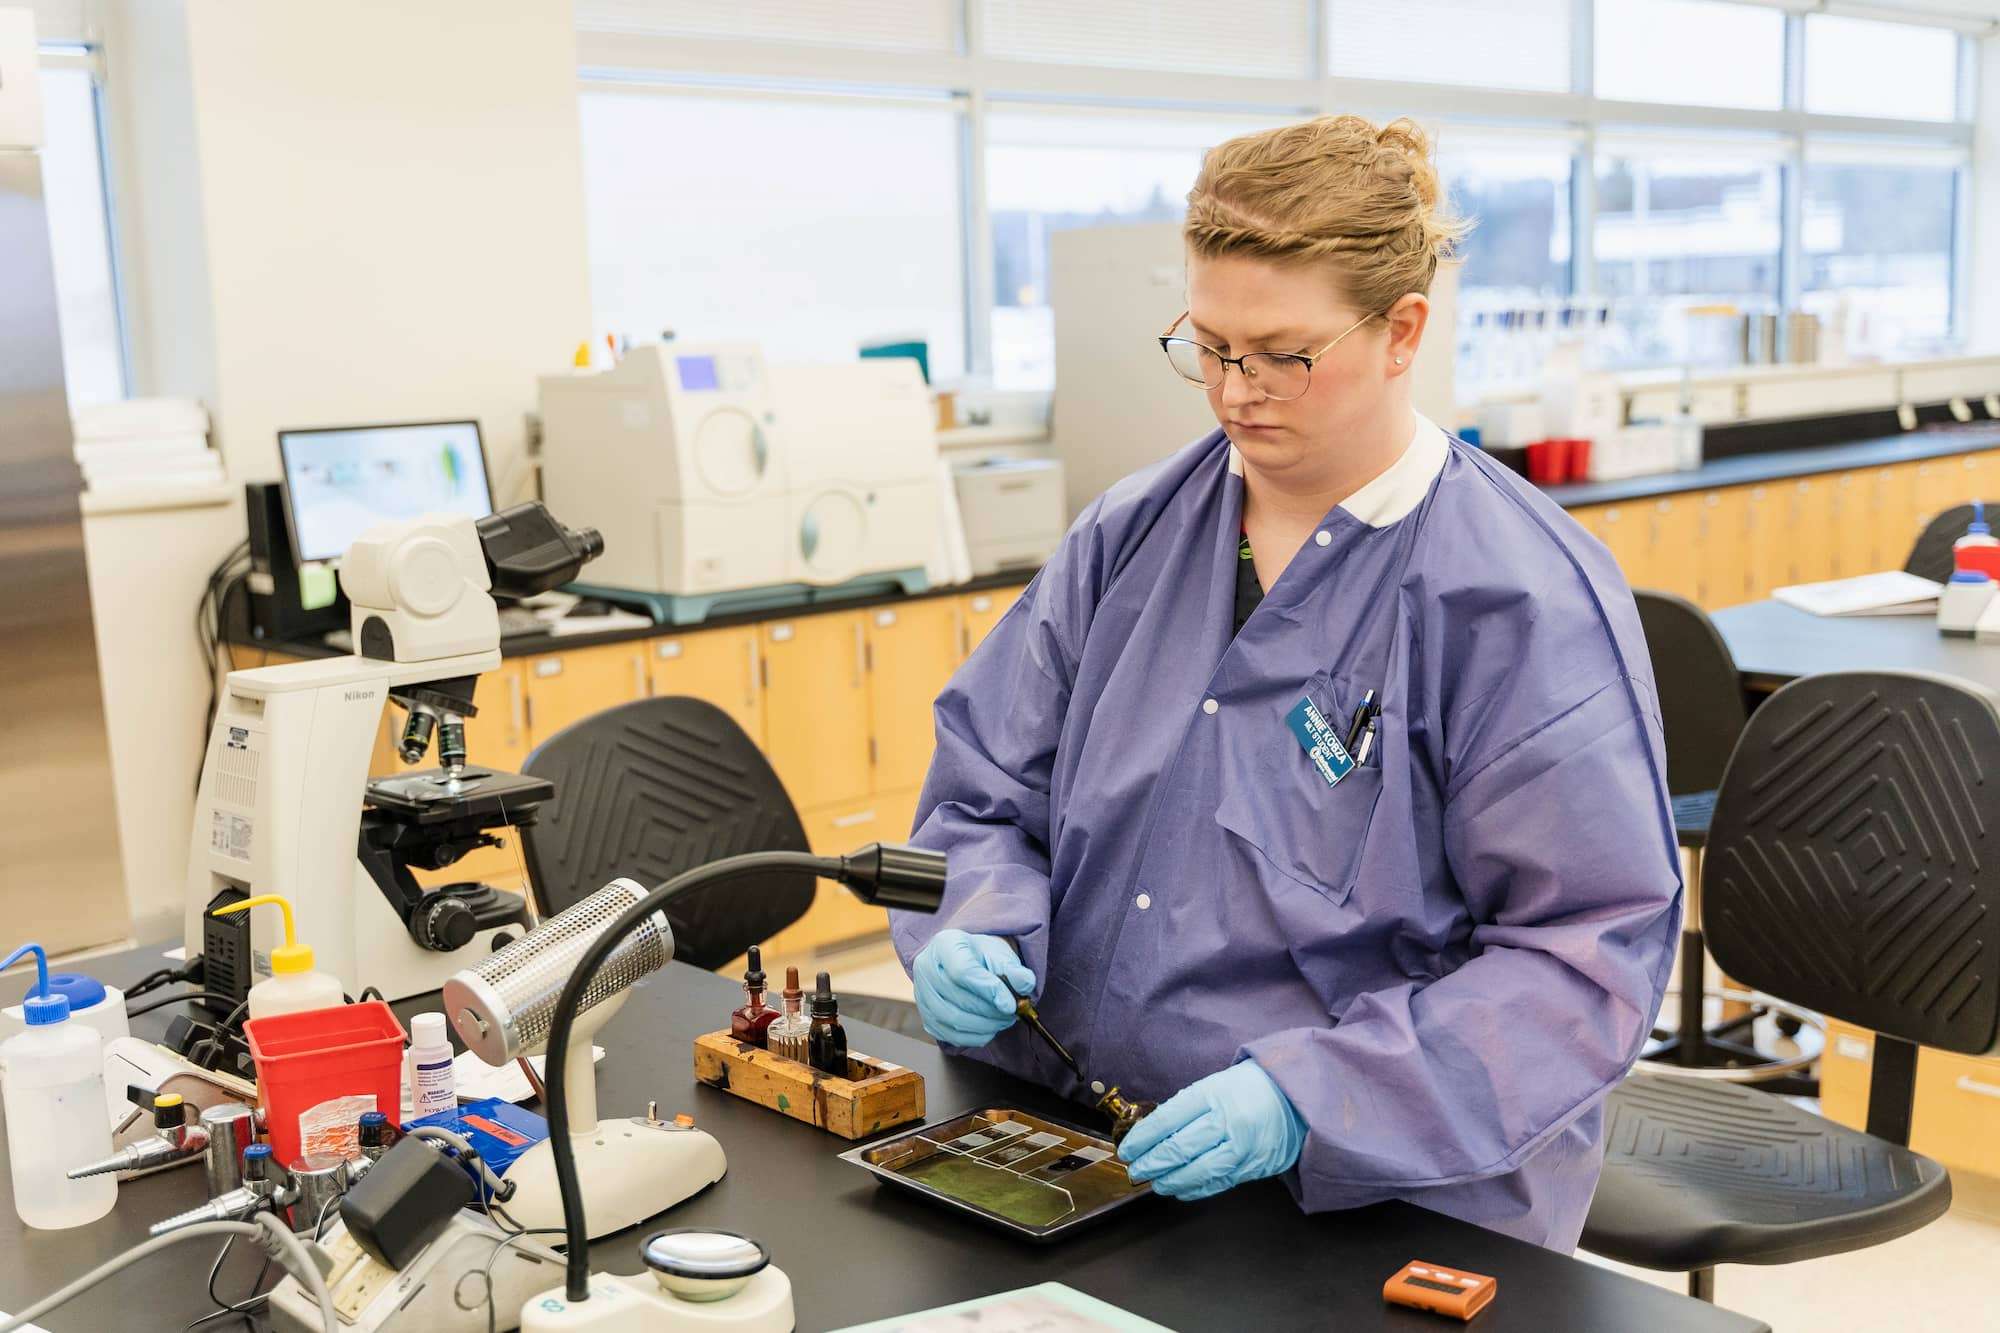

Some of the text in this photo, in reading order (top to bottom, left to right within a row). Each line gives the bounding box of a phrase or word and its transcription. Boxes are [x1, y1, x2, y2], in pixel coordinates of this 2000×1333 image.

[344, 690, 375, 702] Nikon
[1303, 705, 1327, 734] ANNIE
[1322, 731, 1347, 765] KOBZA
[1311, 731, 1335, 760] STUDENT
